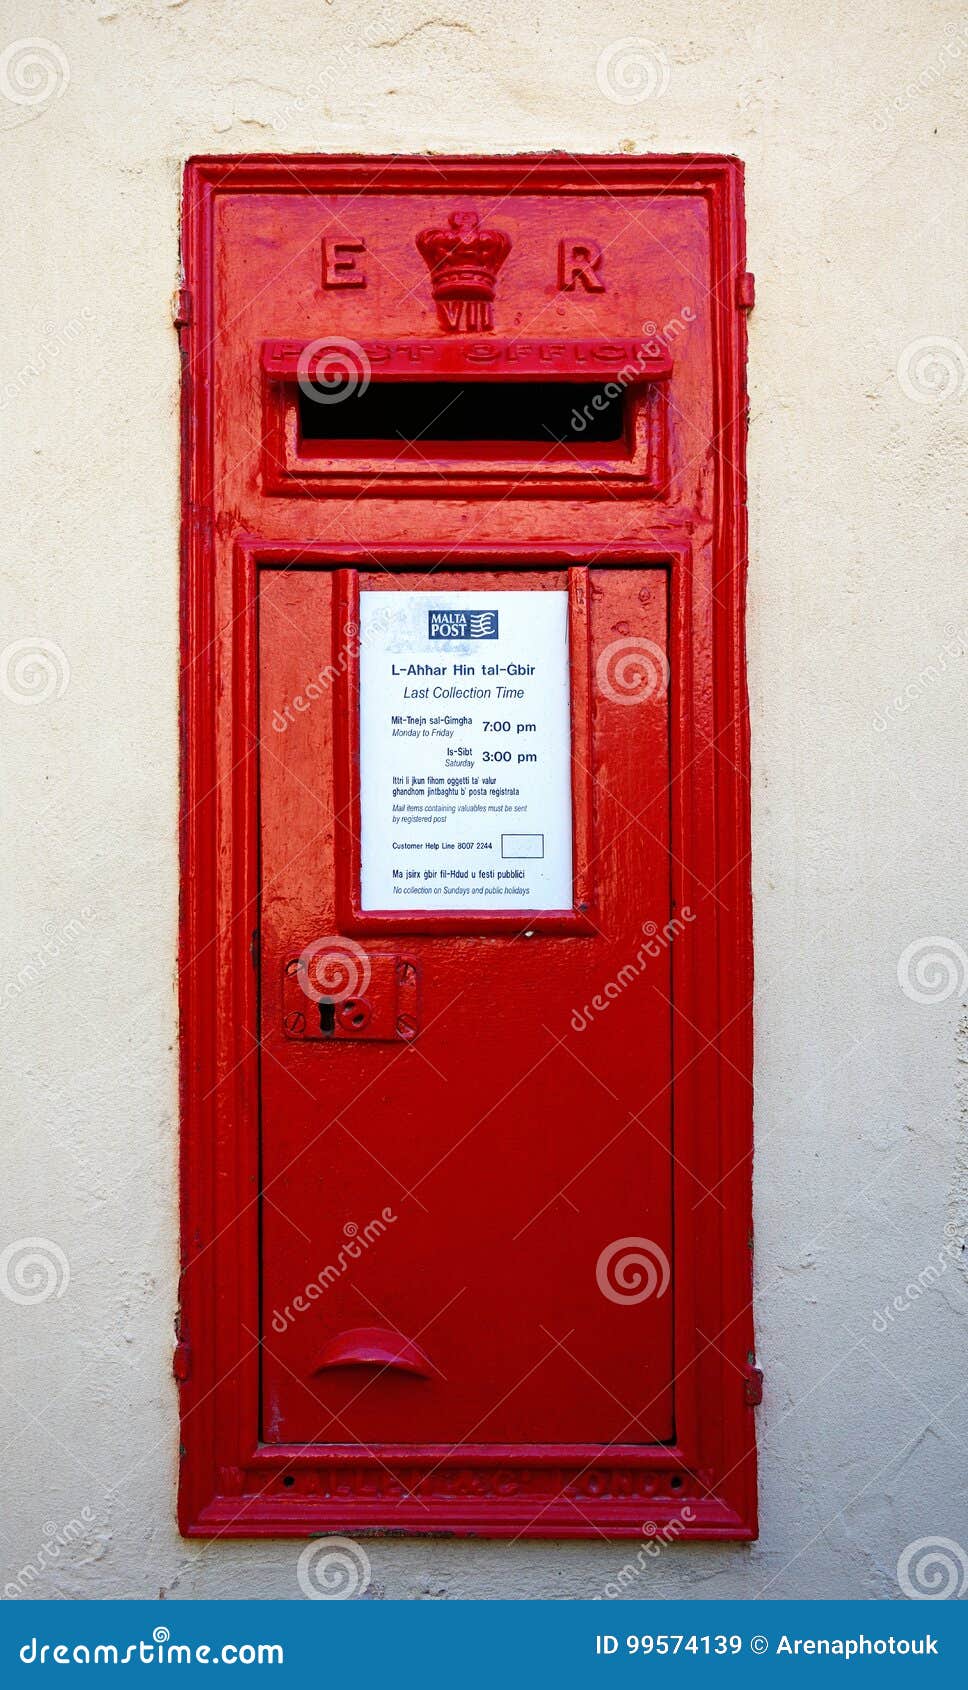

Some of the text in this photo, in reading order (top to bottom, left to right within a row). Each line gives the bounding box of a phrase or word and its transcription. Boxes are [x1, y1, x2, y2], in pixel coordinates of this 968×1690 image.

[322, 237, 366, 290] E
[557, 239, 605, 293] R
[431, 614, 466, 624] MALTA
[431, 624, 467, 637] POST
[404, 686, 524, 699] Last Collection Time
[482, 721, 536, 734] 7:00 pm
[392, 729, 454, 738] Monday to Friday
[447, 747, 472, 756] Is-Sibt
[482, 751, 537, 764] 3:00 pm
[445, 759, 475, 769] Saturday
[468, 788, 487, 798] posta
[392, 804, 528, 814] Mail items containing valuables must be sent
[392, 815, 447, 824] by registered post
[392, 842, 423, 850] Customer
[425, 842, 440, 851] Help
[441, 842, 455, 850] Line
[476, 842, 493, 850] 2244
[392, 869, 403, 878] Ma
[478, 869, 494, 878] festi
[392, 886, 402, 895] No
[403, 886, 432, 895] collection
[443, 886, 470, 896] Sundays
[471, 886, 484, 895] and
[484, 886, 503, 896] public
[504, 886, 530, 896] holidays
